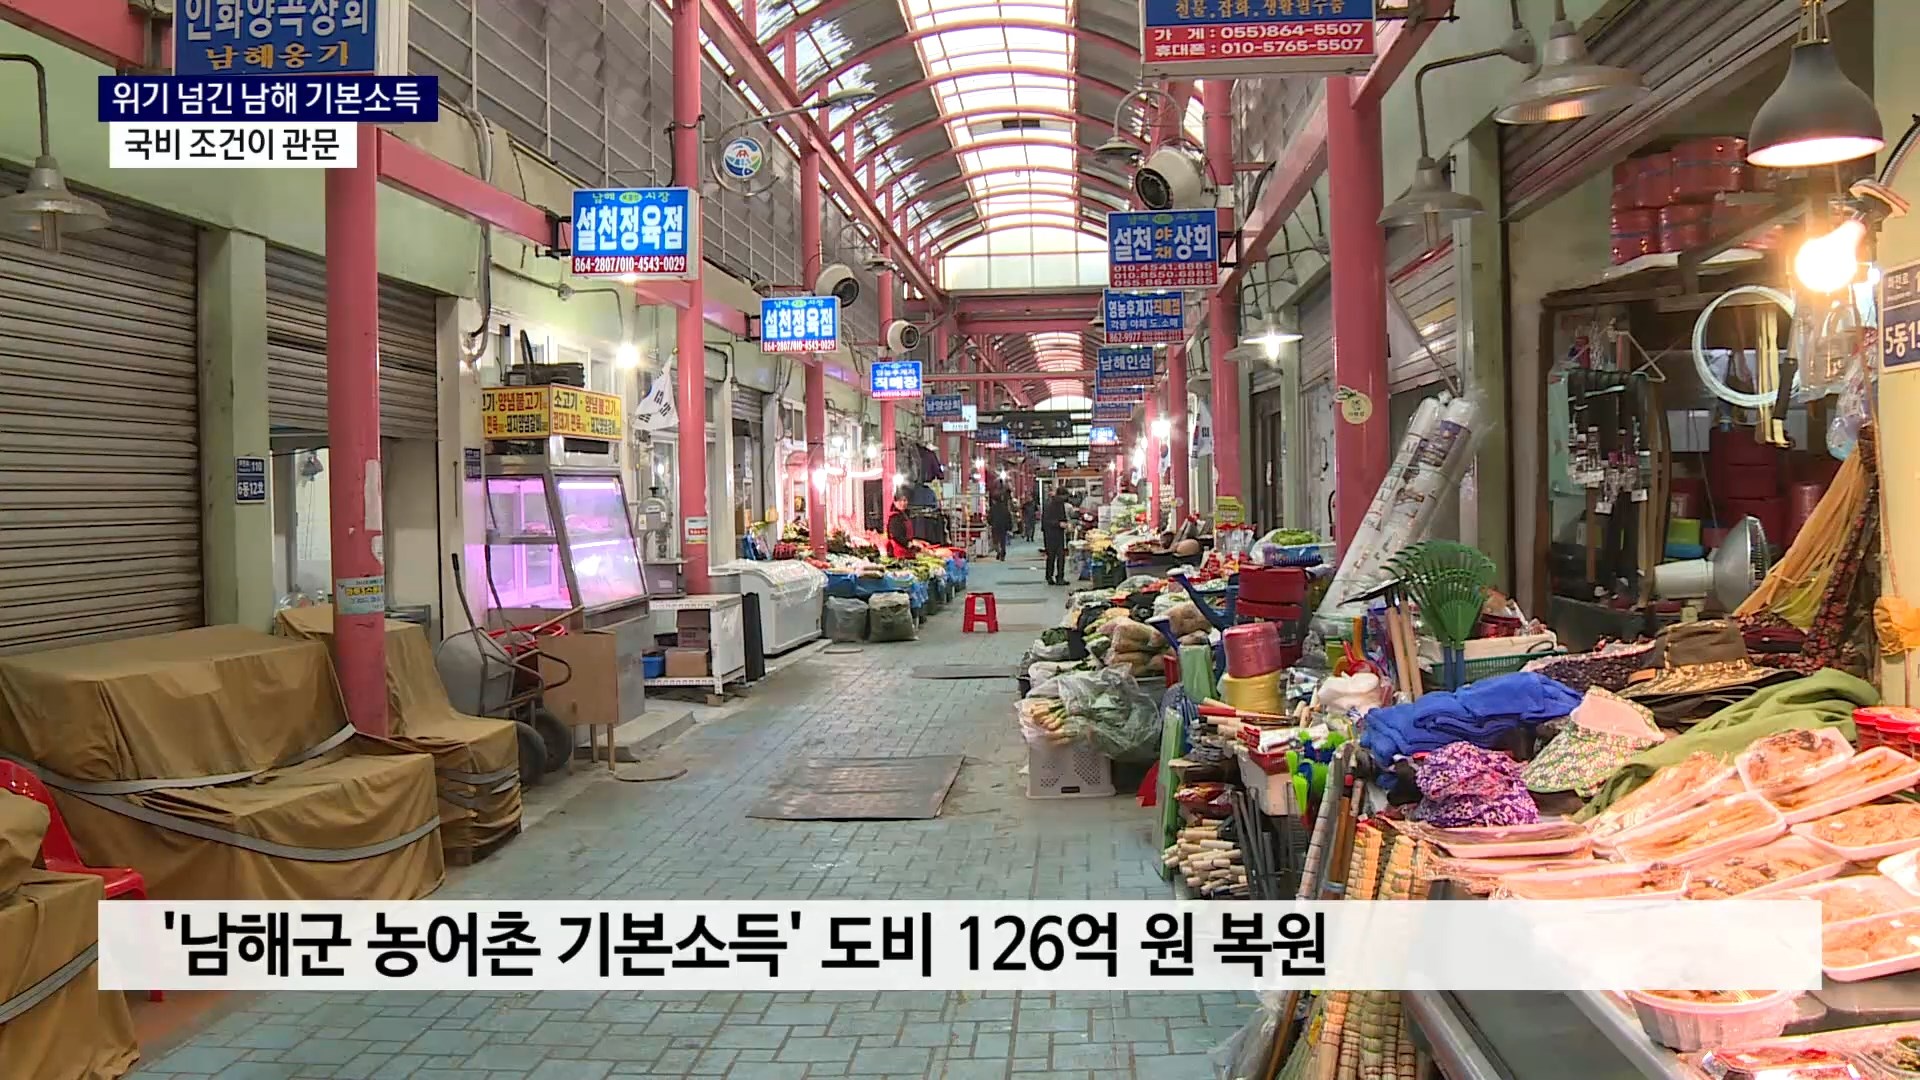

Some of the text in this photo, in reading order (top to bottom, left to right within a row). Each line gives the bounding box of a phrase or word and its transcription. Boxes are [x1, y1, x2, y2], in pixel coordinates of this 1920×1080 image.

[1220, 22, 1363, 38] 055)864-5507
[1155, 43, 1206, 57] 휴대폰
[1220, 38, 1363, 54] 010-5765-5507
[576, 204, 683, 251] 설천정육점
[574, 255, 685, 273] 864-2807/010-4543-0029
[765, 308, 833, 338] 설천정육점
[1885, 319, 1920, 358] 5동1
[1101, 354, 1151, 371] 남해인삼
[498, 391, 544, 412] 양념불고기
[553, 390, 617, 416] 소고기 양념불고기
[238, 481, 264, 497] 6동12호
